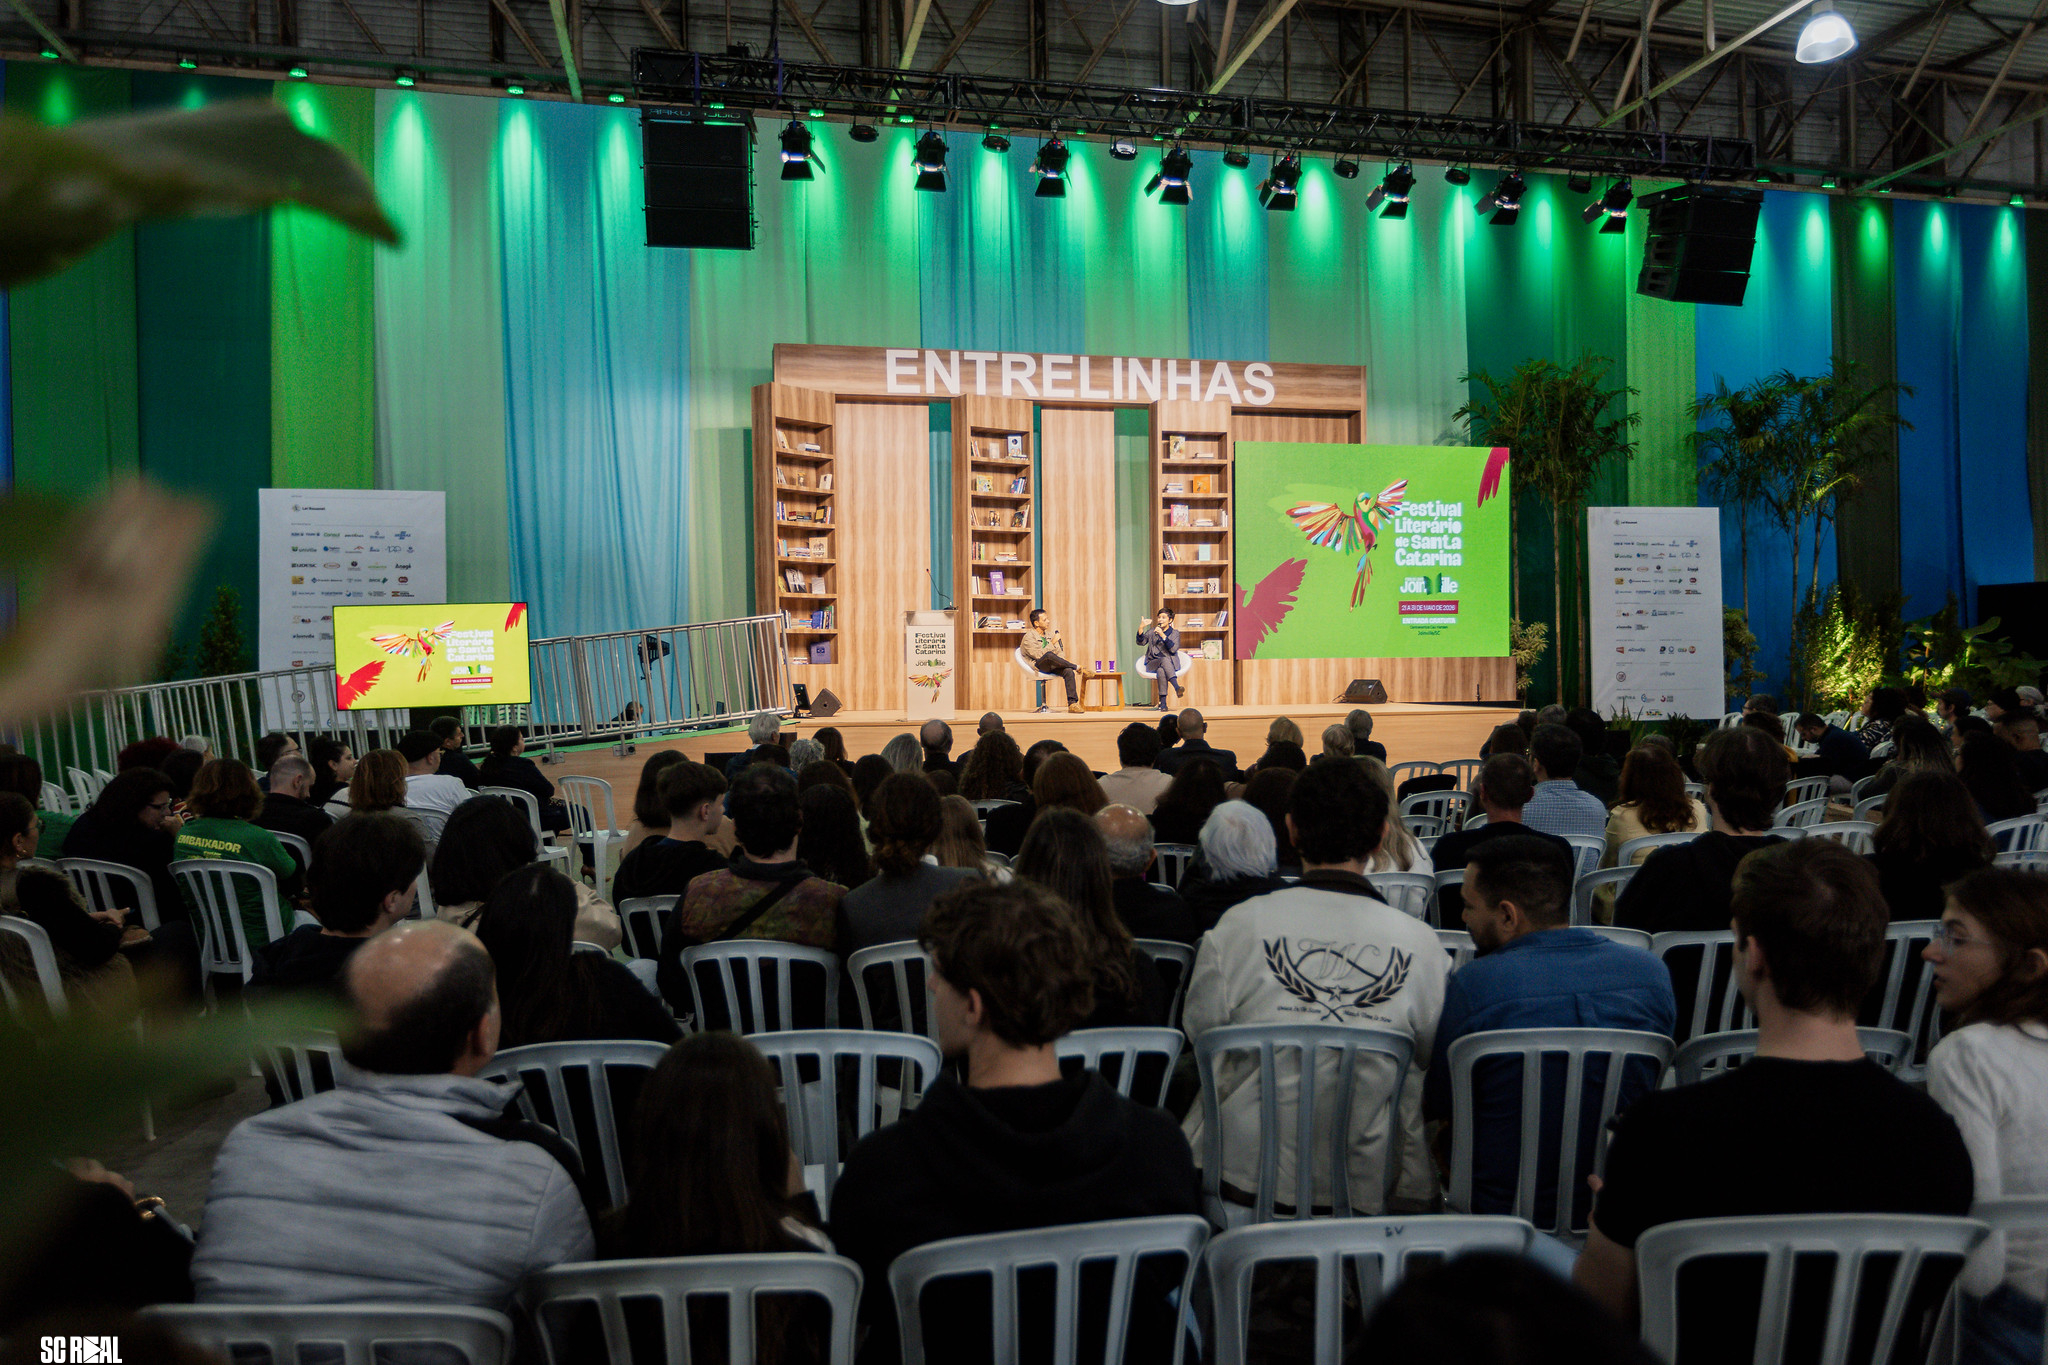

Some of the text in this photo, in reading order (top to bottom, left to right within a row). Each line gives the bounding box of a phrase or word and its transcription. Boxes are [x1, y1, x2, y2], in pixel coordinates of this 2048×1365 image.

[885, 349, 1276, 406] ENTRELINHAS
[1395, 500, 1462, 517] Festival
[1395, 516, 1462, 534] Literário
[1395, 534, 1462, 550] de Santa
[1395, 548, 1462, 566] Catarina
[447, 653, 495, 662] Catarina
[458, 645, 494, 654] Santa
[177, 834, 241, 853] EMBAIXADOR
